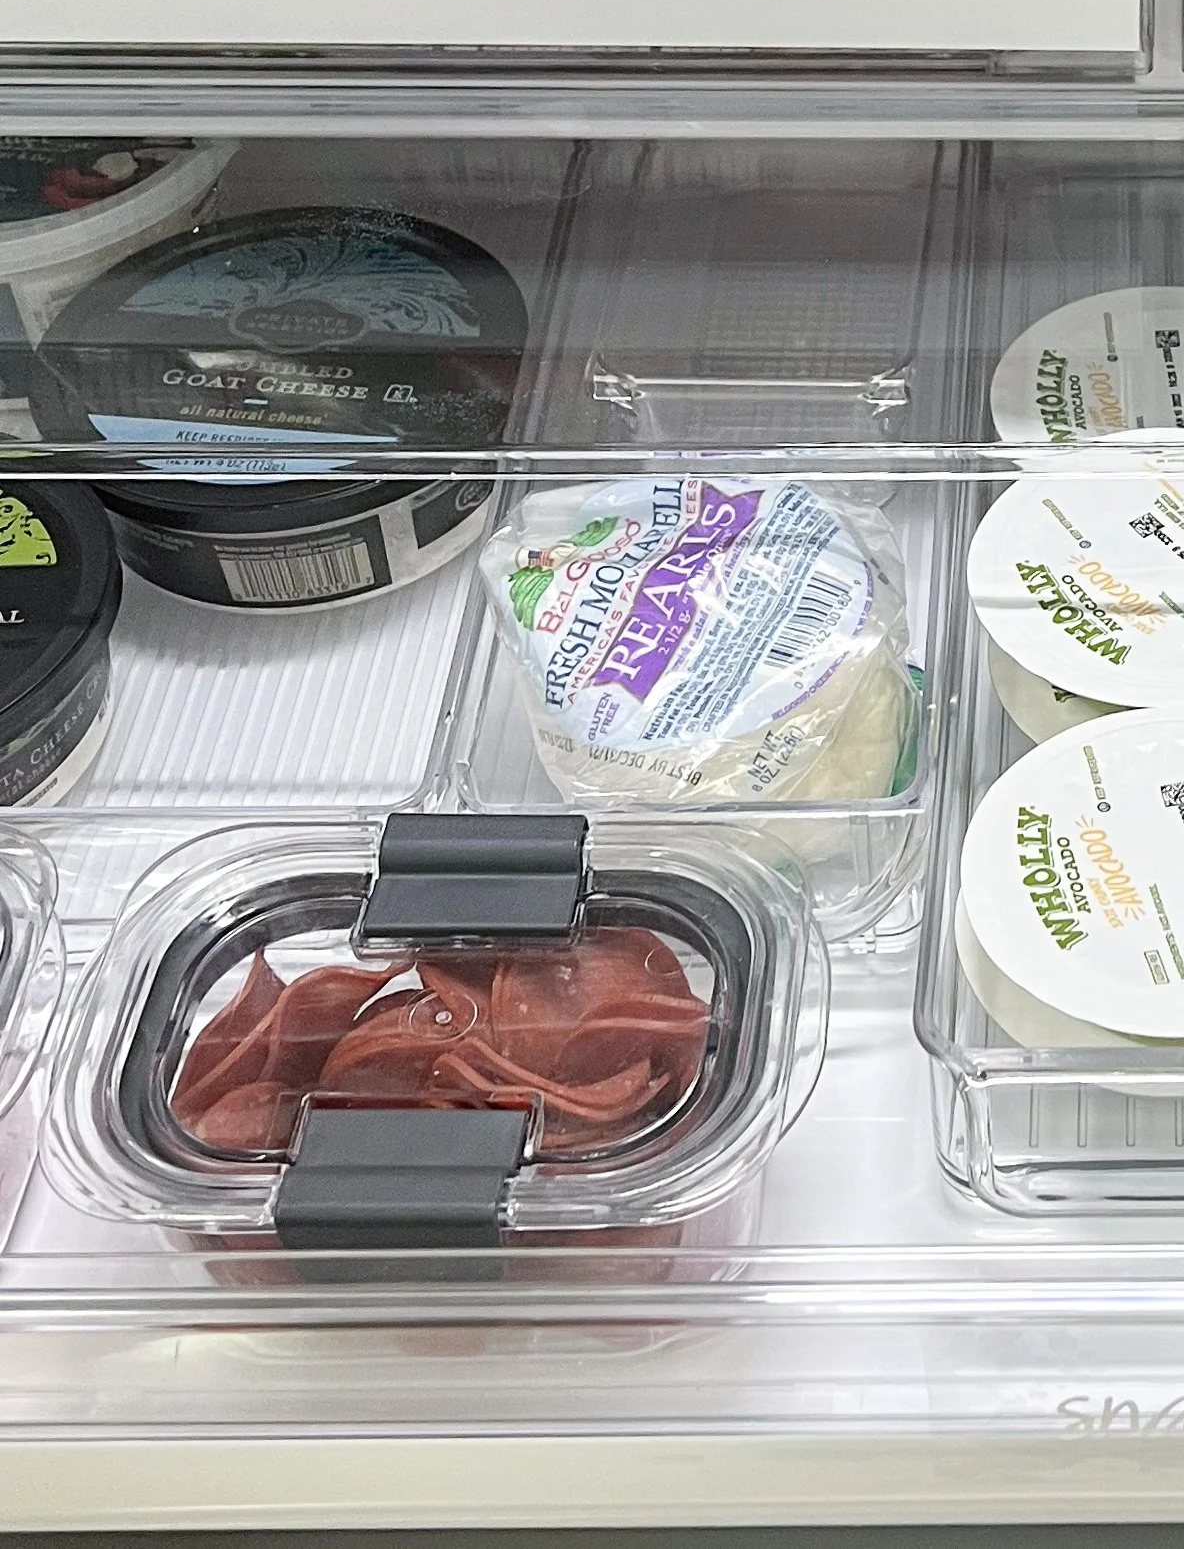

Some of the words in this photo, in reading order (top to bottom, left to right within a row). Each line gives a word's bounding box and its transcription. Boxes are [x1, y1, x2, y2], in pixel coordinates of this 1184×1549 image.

[163, 369, 246, 389] GOAT
[256, 376, 368, 400] CHEESE
[1069, 375, 1086, 430] AVOCADO
[176, 430, 208, 441] KEEP
[180, 405, 201, 415] all
[206, 407, 262, 421] natural
[601, 502, 737, 680] PEARLS
[1015, 562, 1133, 666] WHOLLY
[1062, 575, 1123, 632] AVOCADO
[1079, 562, 1161, 618] AVOCADO
[545, 614, 602, 710] FRESH
[567, 610, 623, 704] AMERICA'S
[664, 626, 682, 644] 1/2
[30, 702, 84, 764] CHEESE
[589, 692, 613, 741] GLUTEN
[600, 702, 620, 734] FREE
[748, 752, 770, 778] NET
[1018, 806, 1088, 950] WHOLLY
[1057, 837, 1091, 913] AVOCADO
[1080, 830, 1142, 905] AVOCADO
